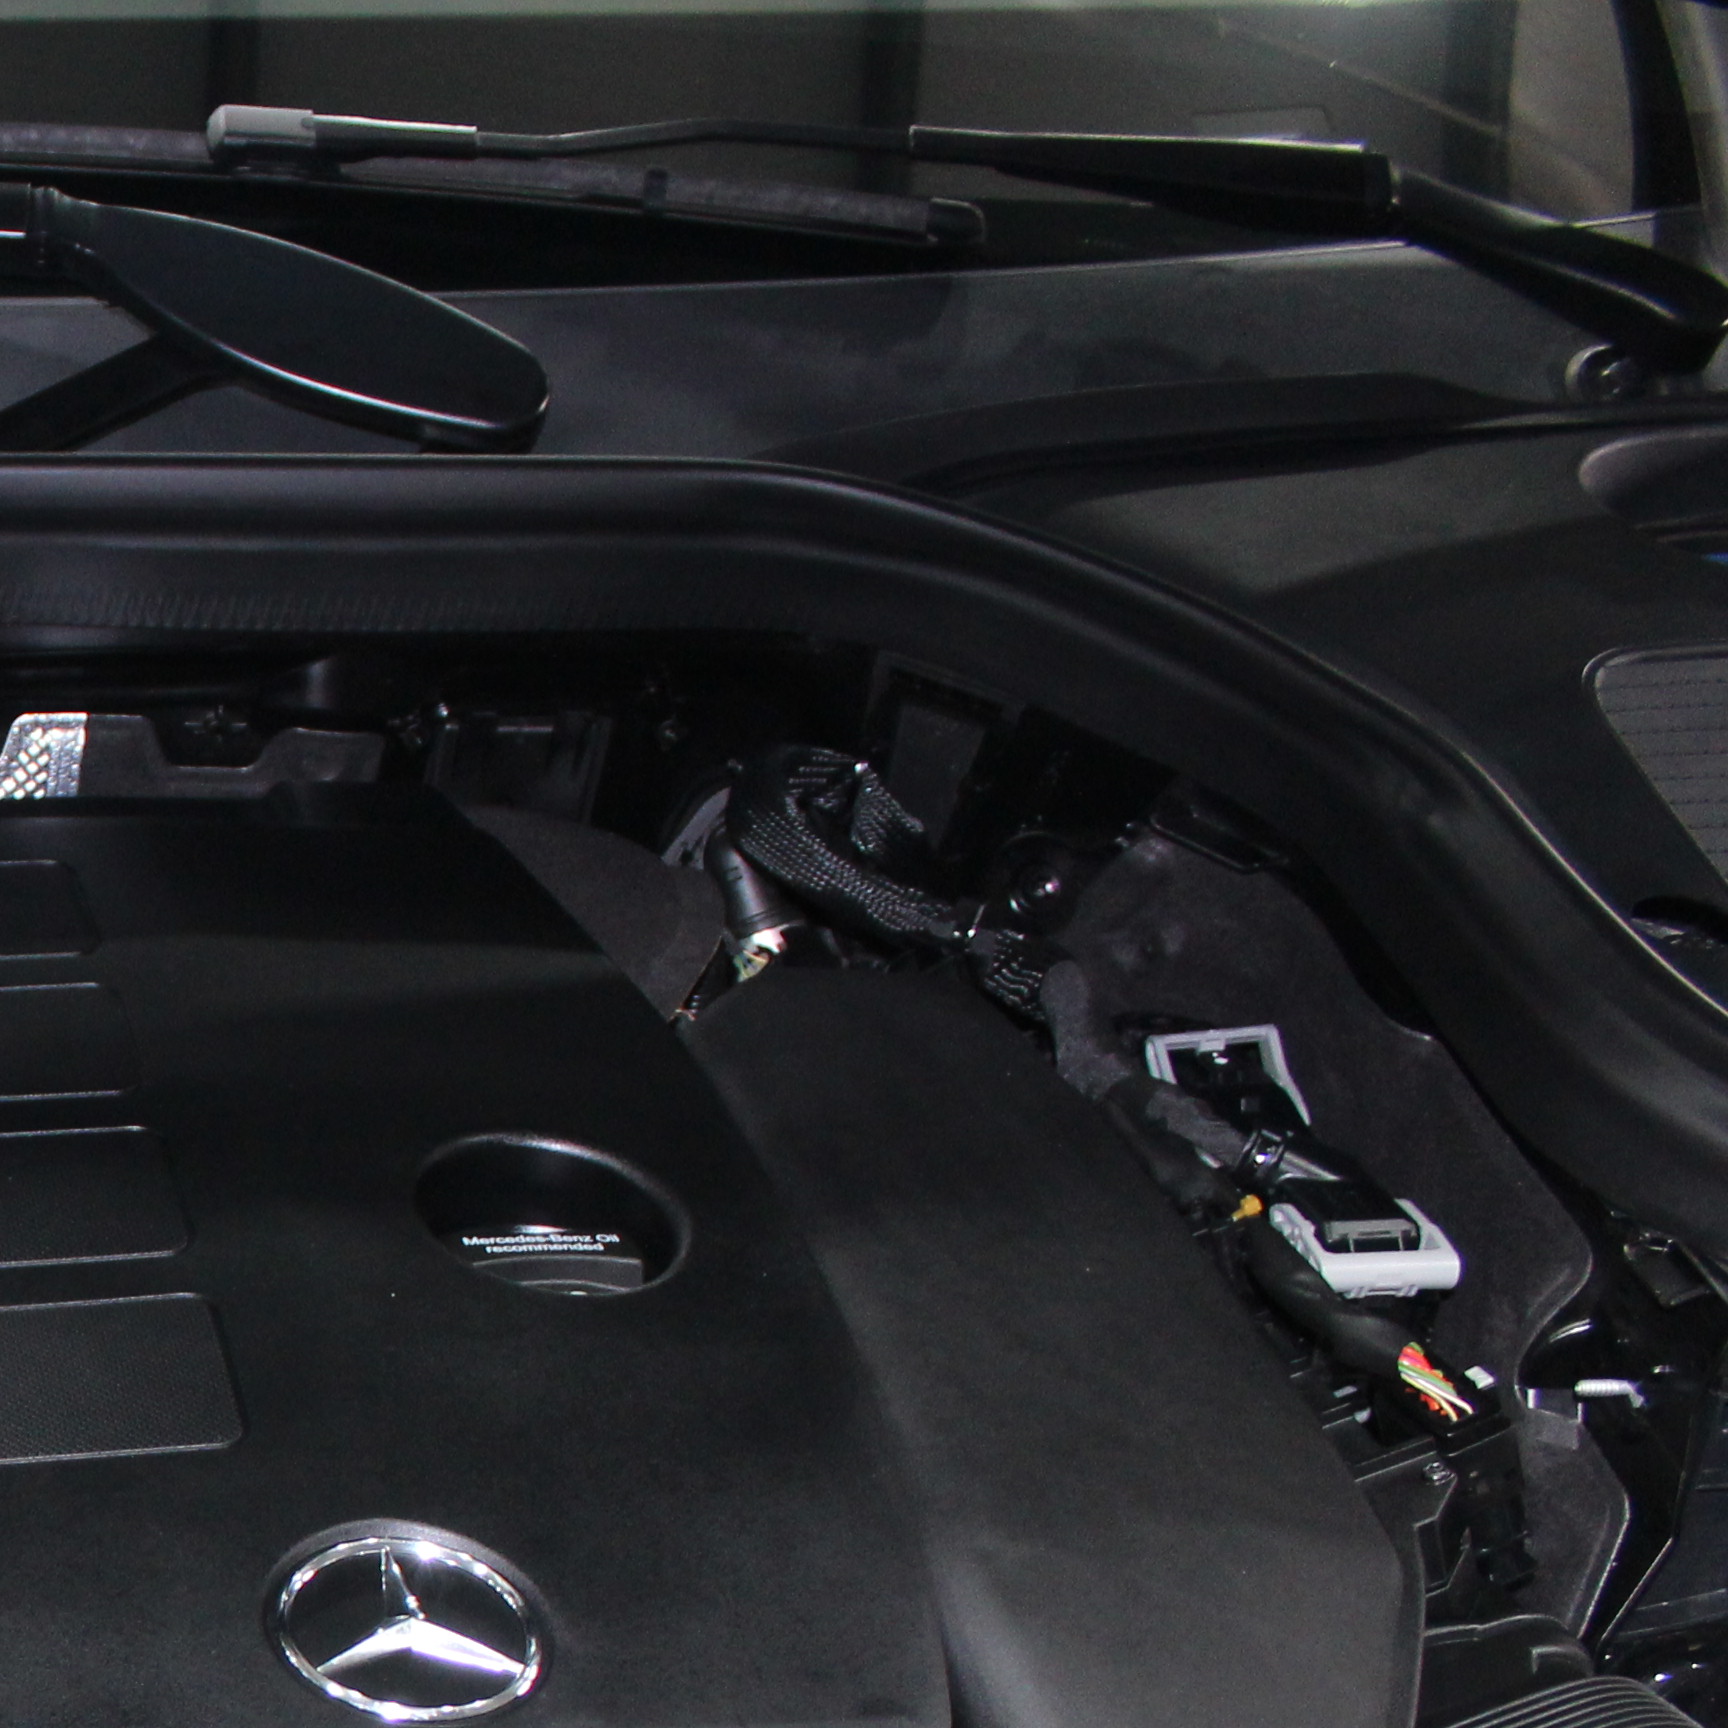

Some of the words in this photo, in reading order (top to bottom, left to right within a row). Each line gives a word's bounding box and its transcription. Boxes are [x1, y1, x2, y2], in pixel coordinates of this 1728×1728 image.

[462, 1235, 593, 1245] Mercedes-Benz
[595, 1233, 620, 1244] Oil
[485, 1243, 604, 1253] recommended
